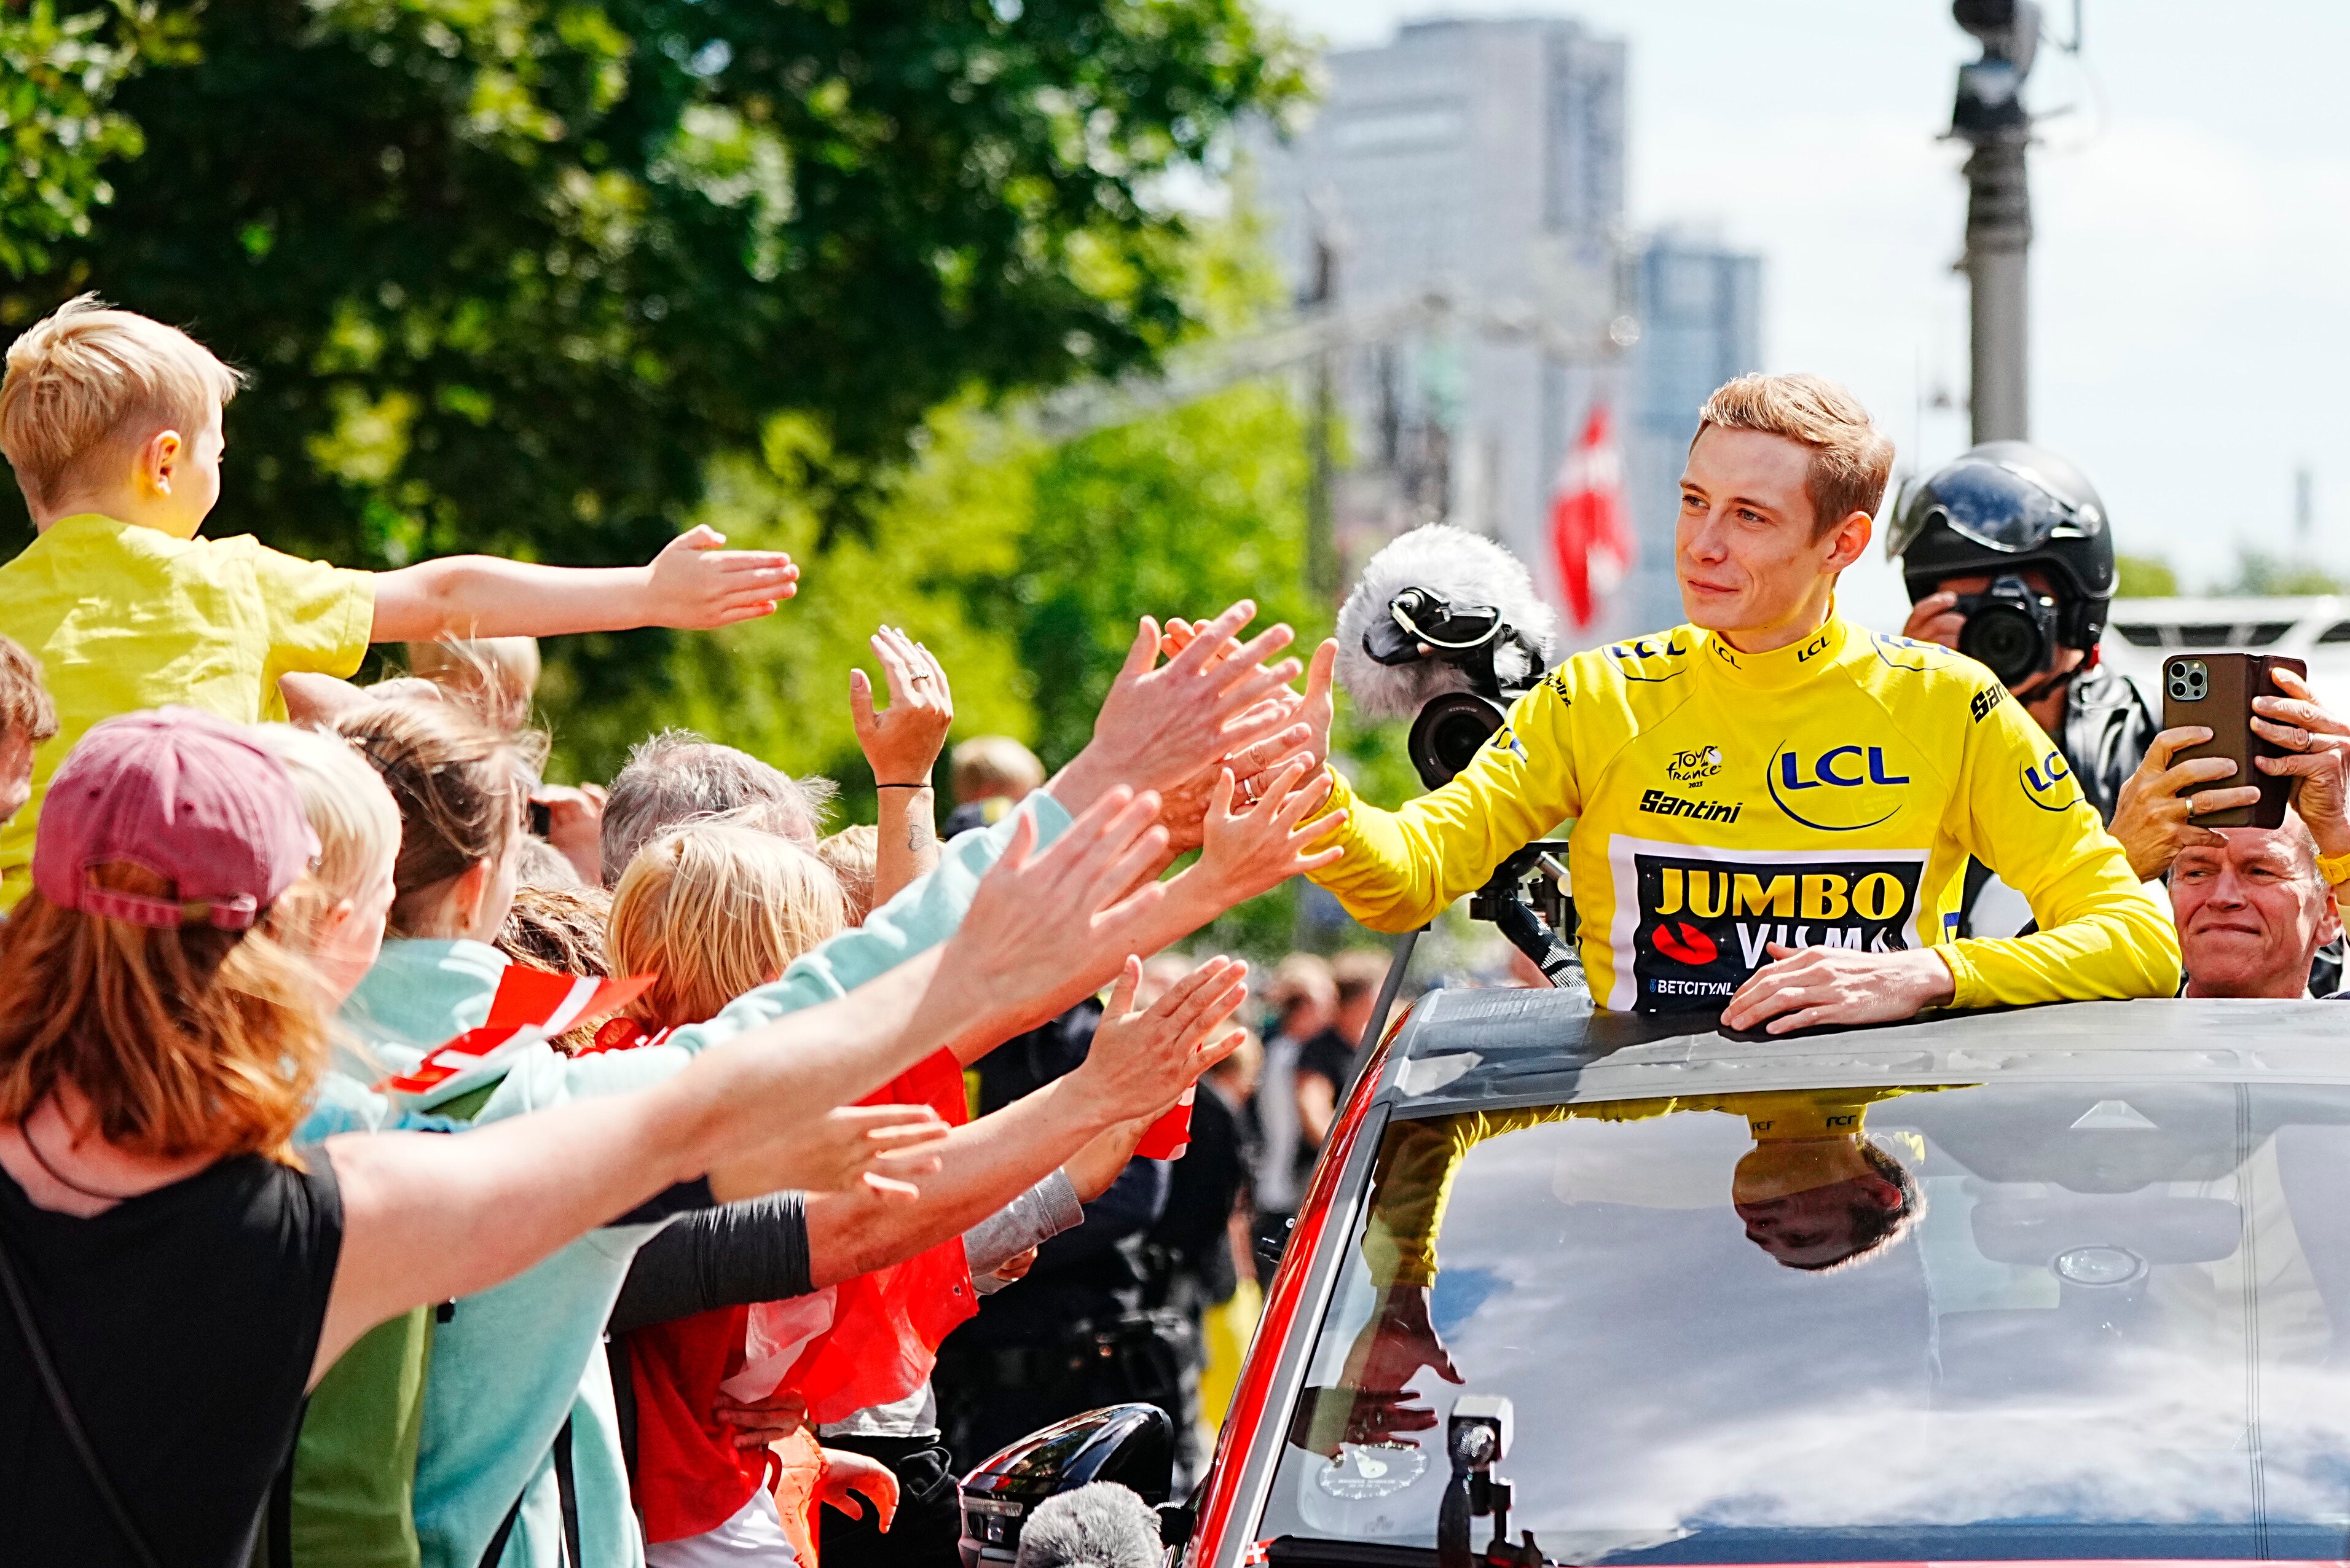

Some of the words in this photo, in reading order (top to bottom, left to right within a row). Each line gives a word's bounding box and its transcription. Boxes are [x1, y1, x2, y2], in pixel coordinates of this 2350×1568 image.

[1612, 639, 1686, 659] LCL
[1712, 638, 1742, 670] LCL
[1798, 636, 1831, 662] LCL
[1782, 745, 1909, 790] LCL
[1639, 789, 1743, 823] Santini
[1655, 868, 1905, 920] JUMBO
[1657, 979, 1735, 996] BETCITY.NL
